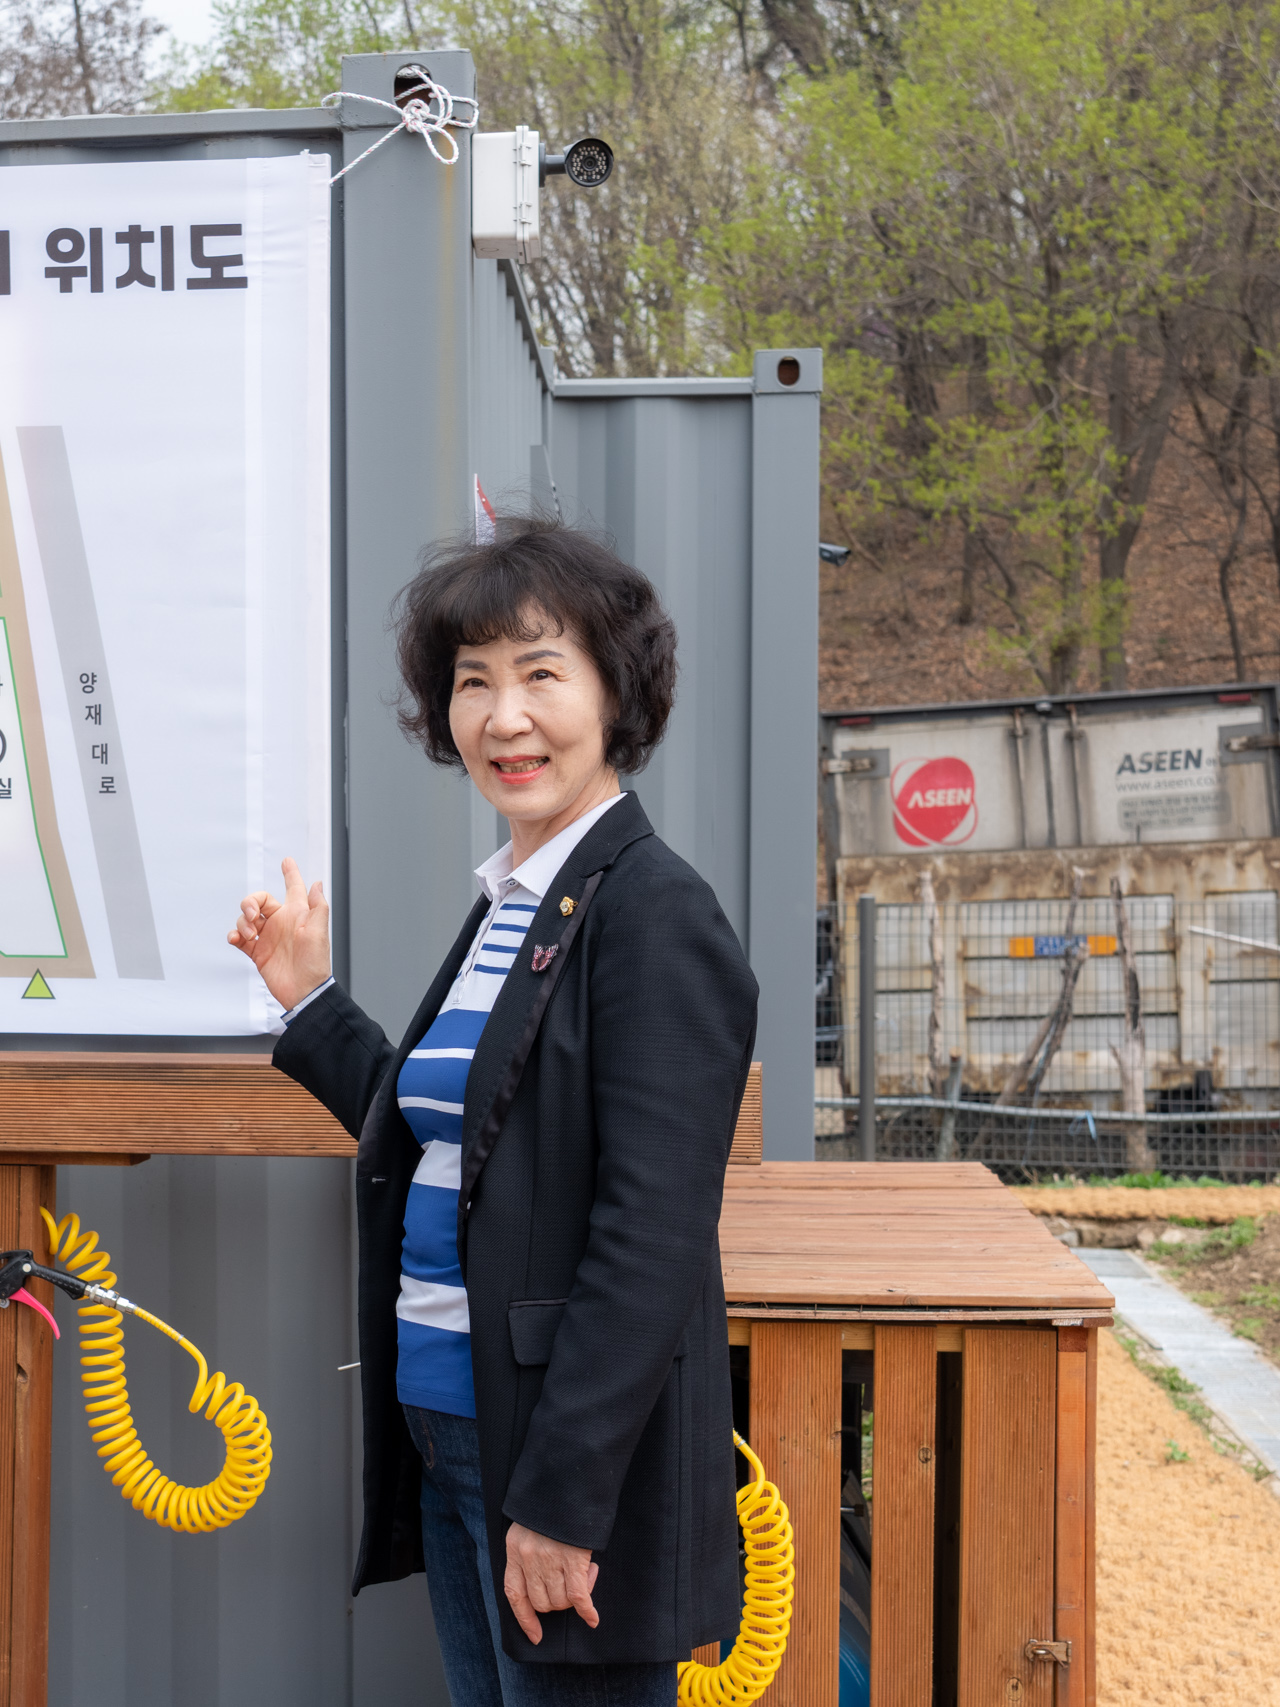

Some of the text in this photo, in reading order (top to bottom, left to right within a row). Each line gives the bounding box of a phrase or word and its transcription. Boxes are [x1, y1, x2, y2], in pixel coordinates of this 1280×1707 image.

[44, 223, 248, 294] 위치도
[79, 672, 117, 794] 양재대로
[1116, 748, 1203, 776] ASEEN
[908, 786, 972, 808] ASEEN
